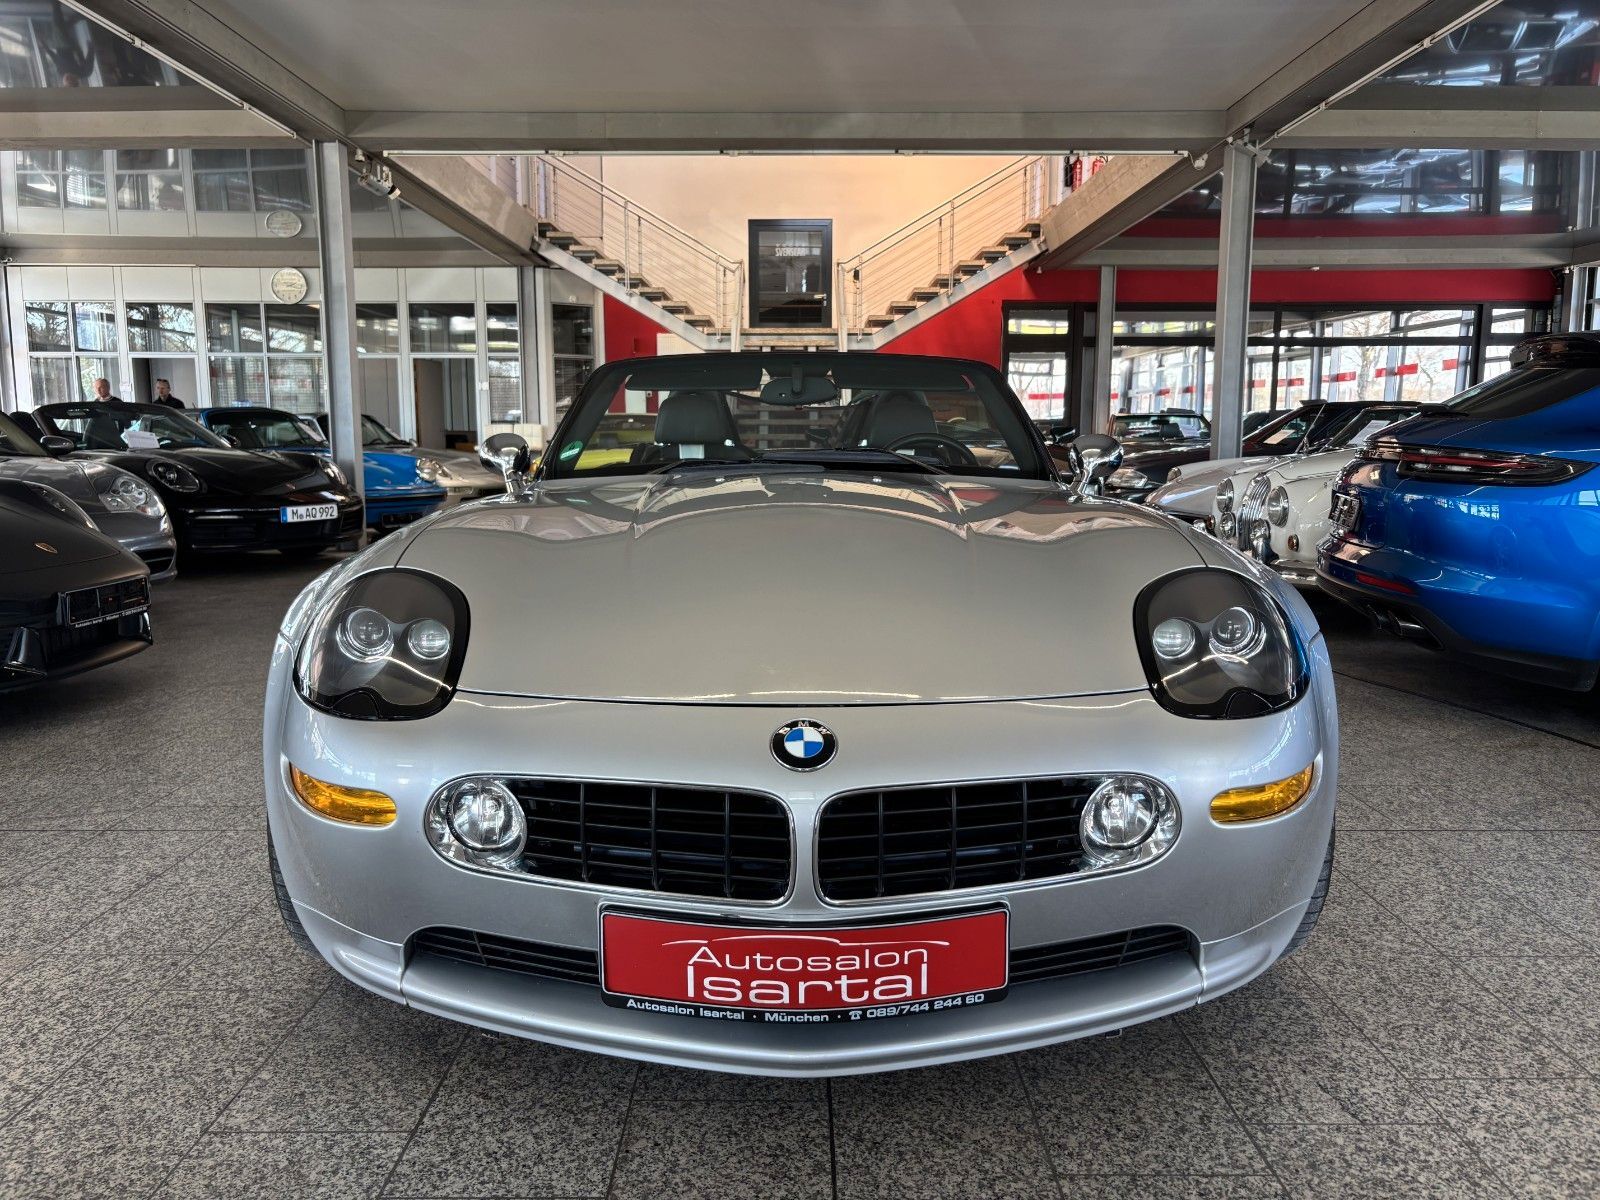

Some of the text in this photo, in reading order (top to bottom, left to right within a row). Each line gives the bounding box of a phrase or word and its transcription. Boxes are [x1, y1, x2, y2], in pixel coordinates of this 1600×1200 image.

[291, 508, 299, 520] M
[319, 506, 335, 518] 992
[688, 946, 928, 972] Autosalon
[687, 963, 928, 1004] Isartal
[626, 993, 985, 1023] Autosalon Isartal München 089/744 244 60
